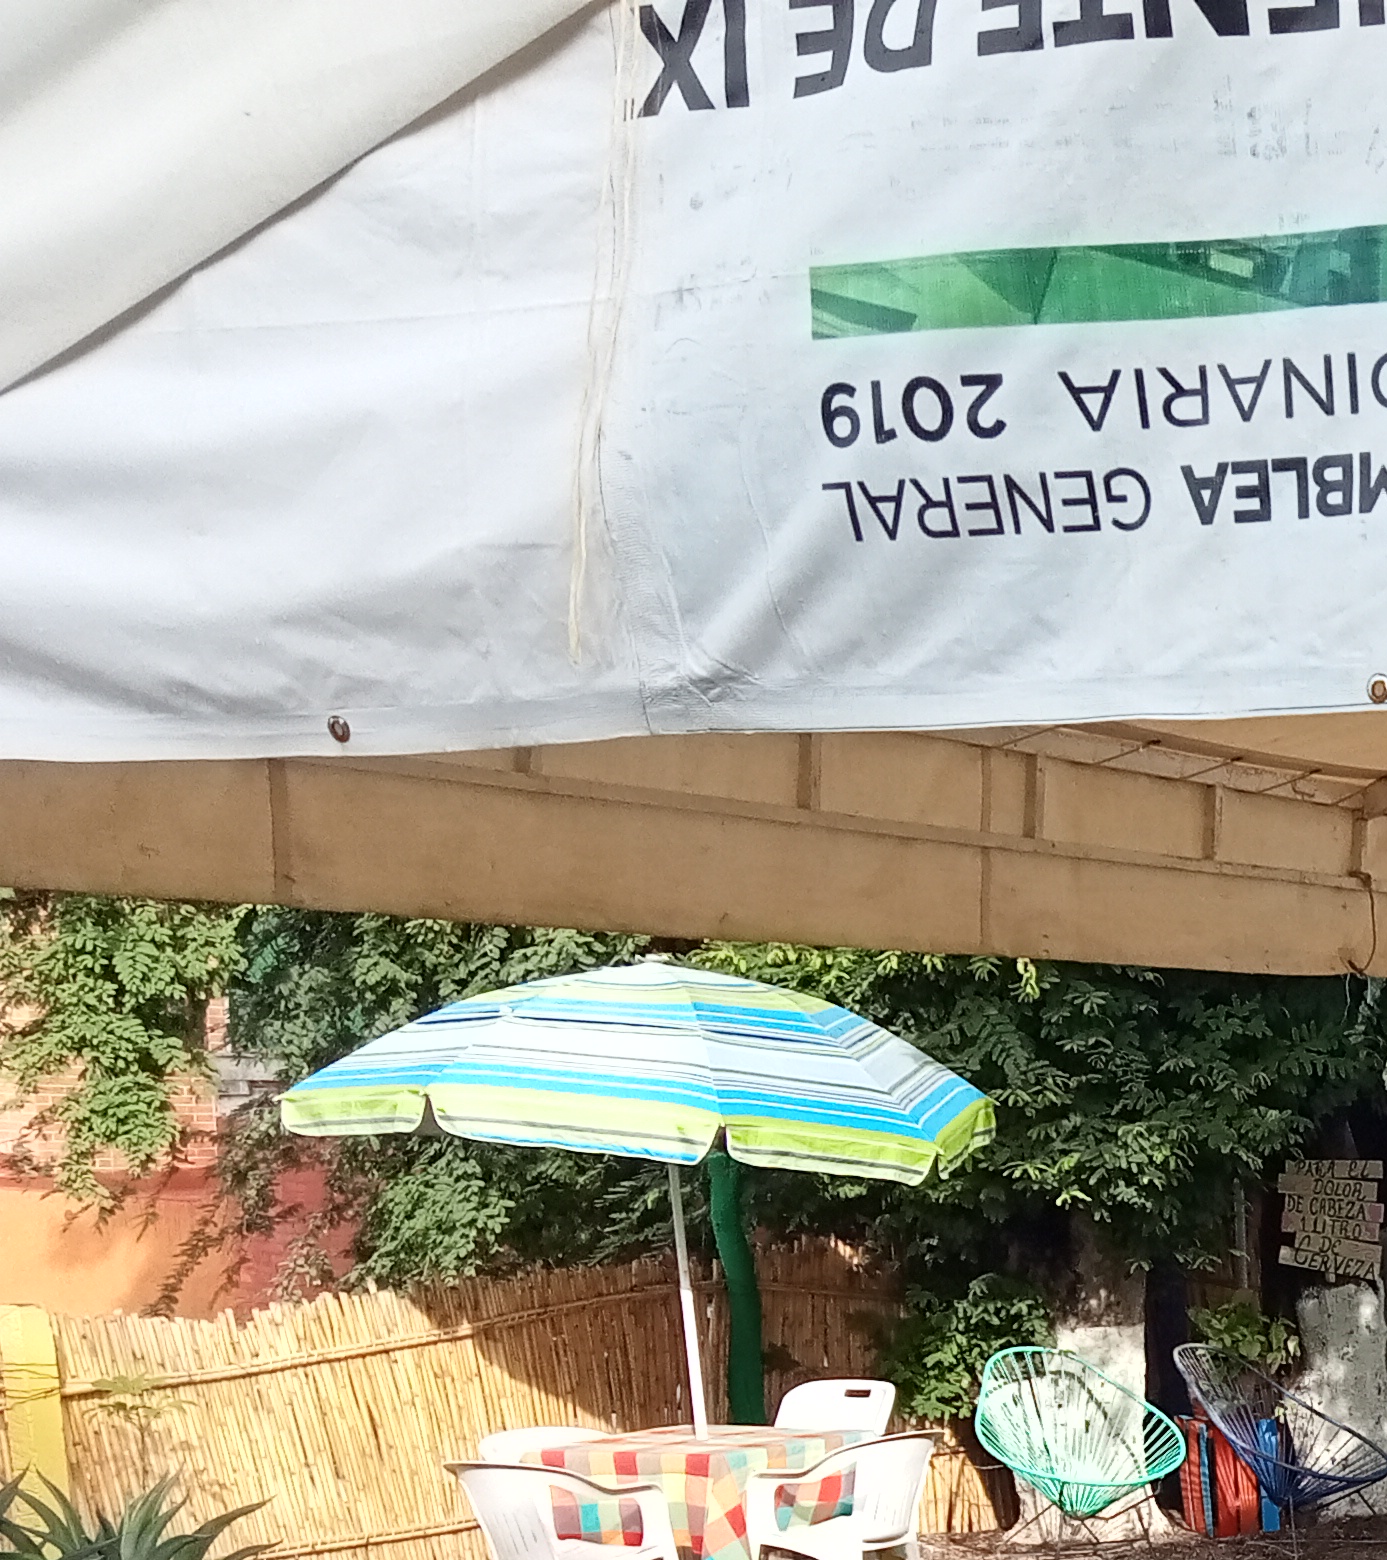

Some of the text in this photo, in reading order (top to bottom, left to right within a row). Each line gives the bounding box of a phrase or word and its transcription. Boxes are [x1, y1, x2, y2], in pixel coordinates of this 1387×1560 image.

[793, 0, 934, 99] DE
[820, 373, 1007, 449] 2019
[821, 466, 1152, 542] GENERAL
[1296, 1160, 1334, 1179] PARA
[1313, 1178, 1366, 1202] DOLOR
[1286, 1194, 1367, 1222] DE CABEZA
[1311, 1217, 1361, 1239] LITRO
[1294, 1235, 1376, 1281] CERVEZA
[1319, 1236, 1342, 1256] DE
